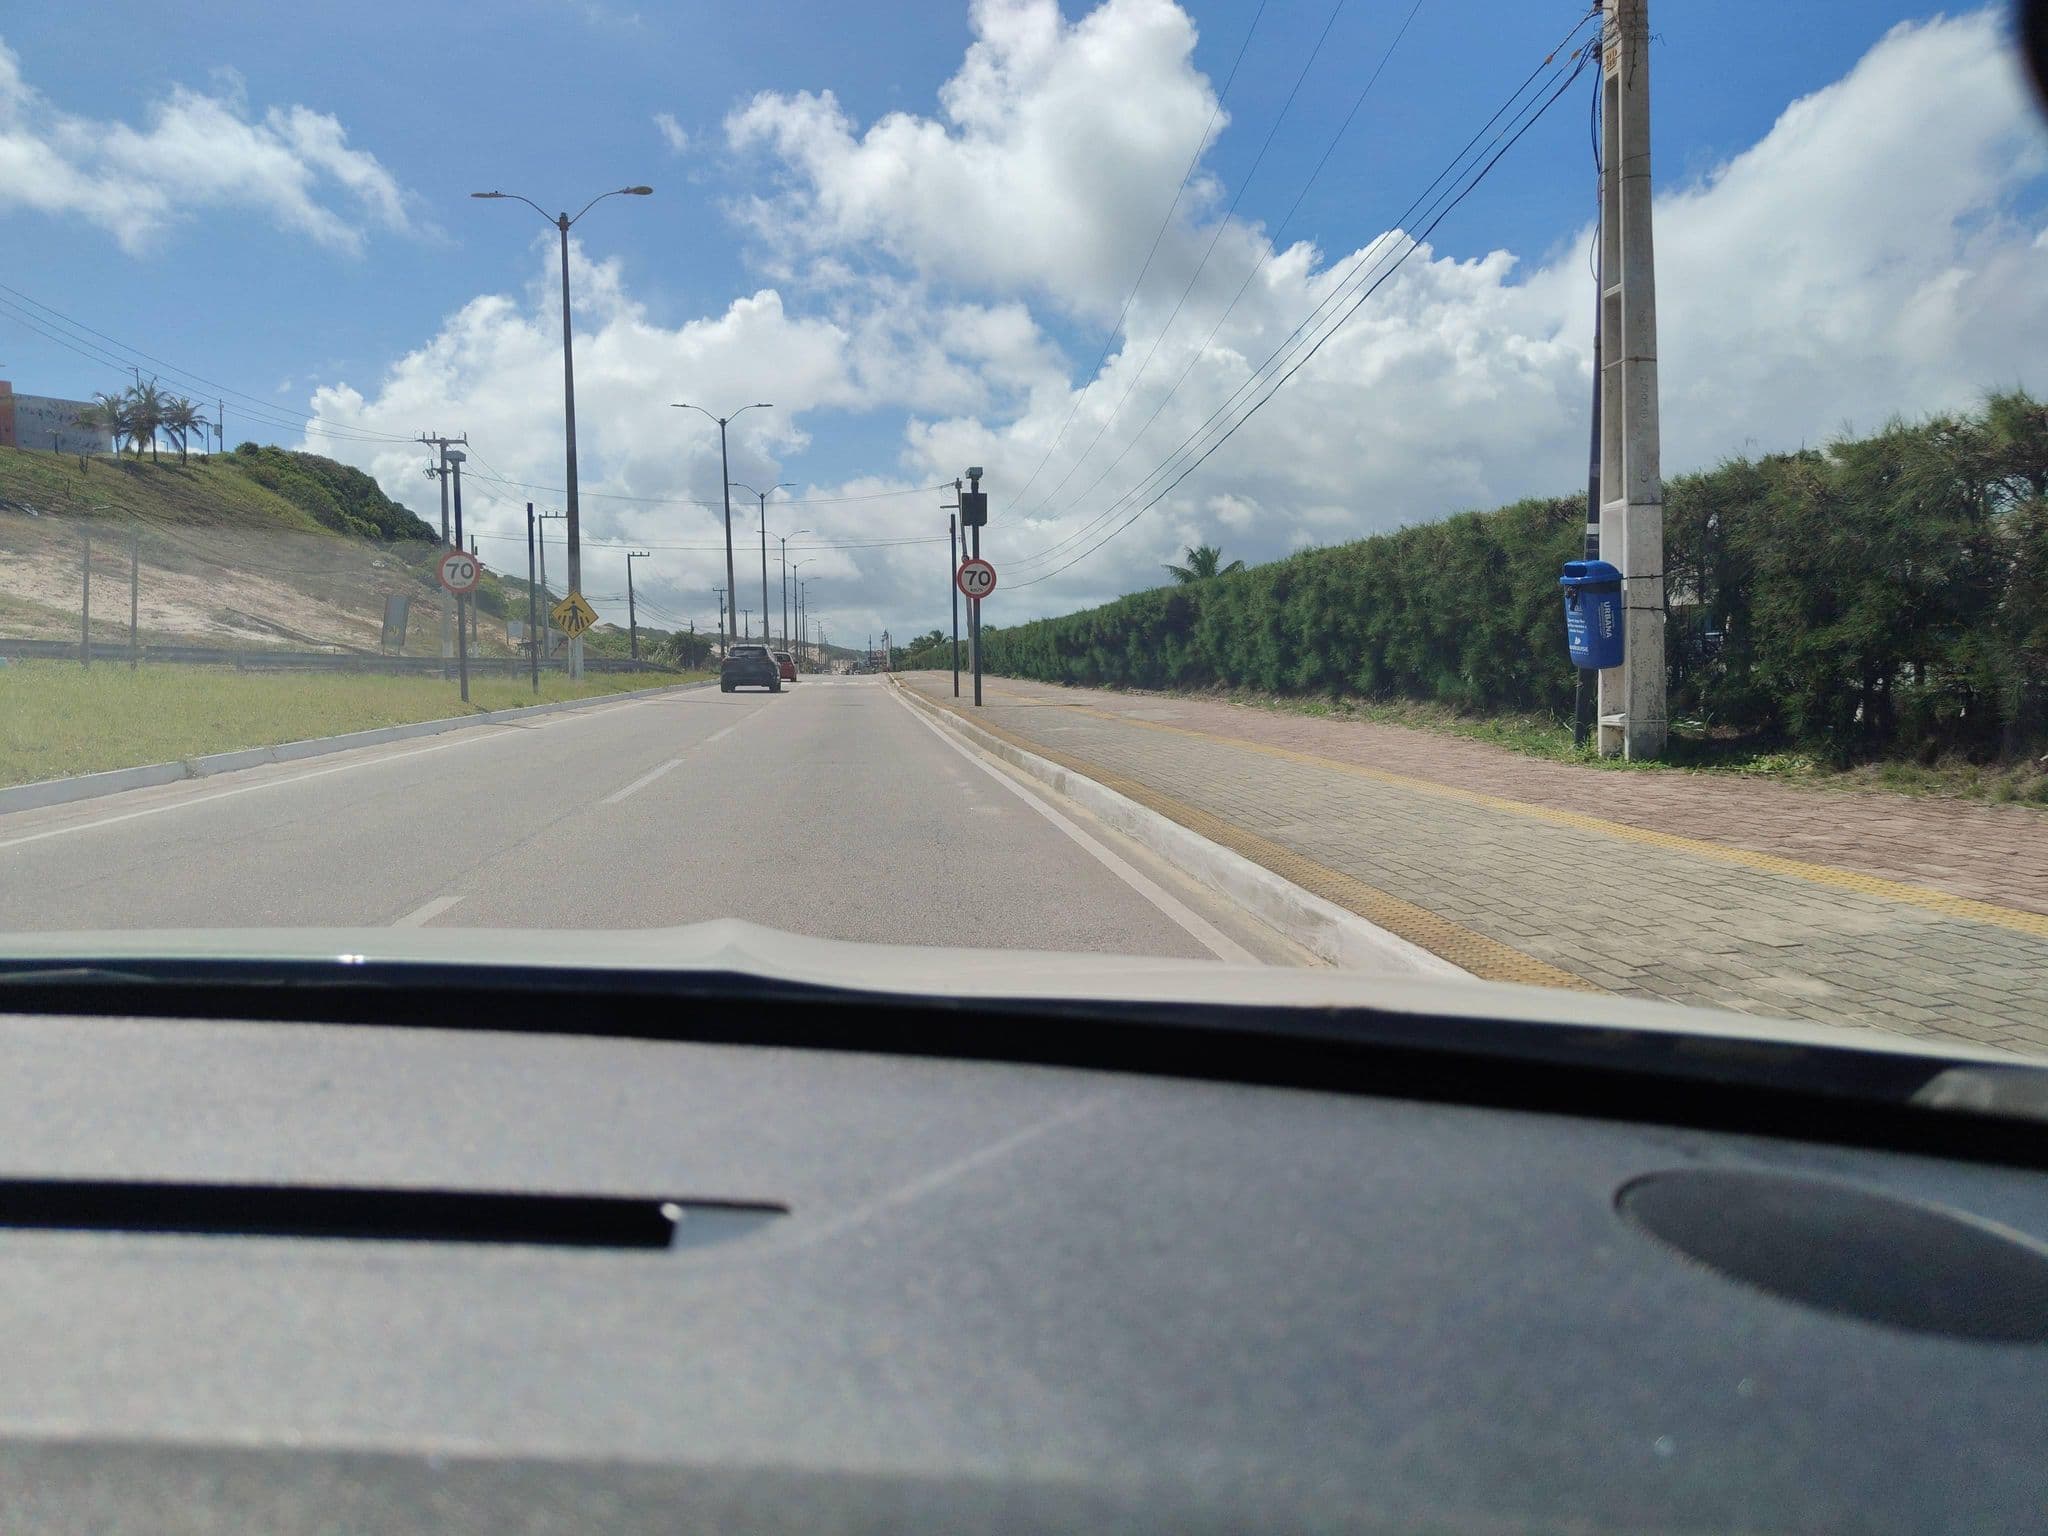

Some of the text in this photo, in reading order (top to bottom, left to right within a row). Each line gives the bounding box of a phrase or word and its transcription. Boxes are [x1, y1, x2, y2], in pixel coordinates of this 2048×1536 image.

[445, 563, 474, 580] 70
[964, 570, 991, 586] 70
[1604, 601, 1613, 638] URBANA
